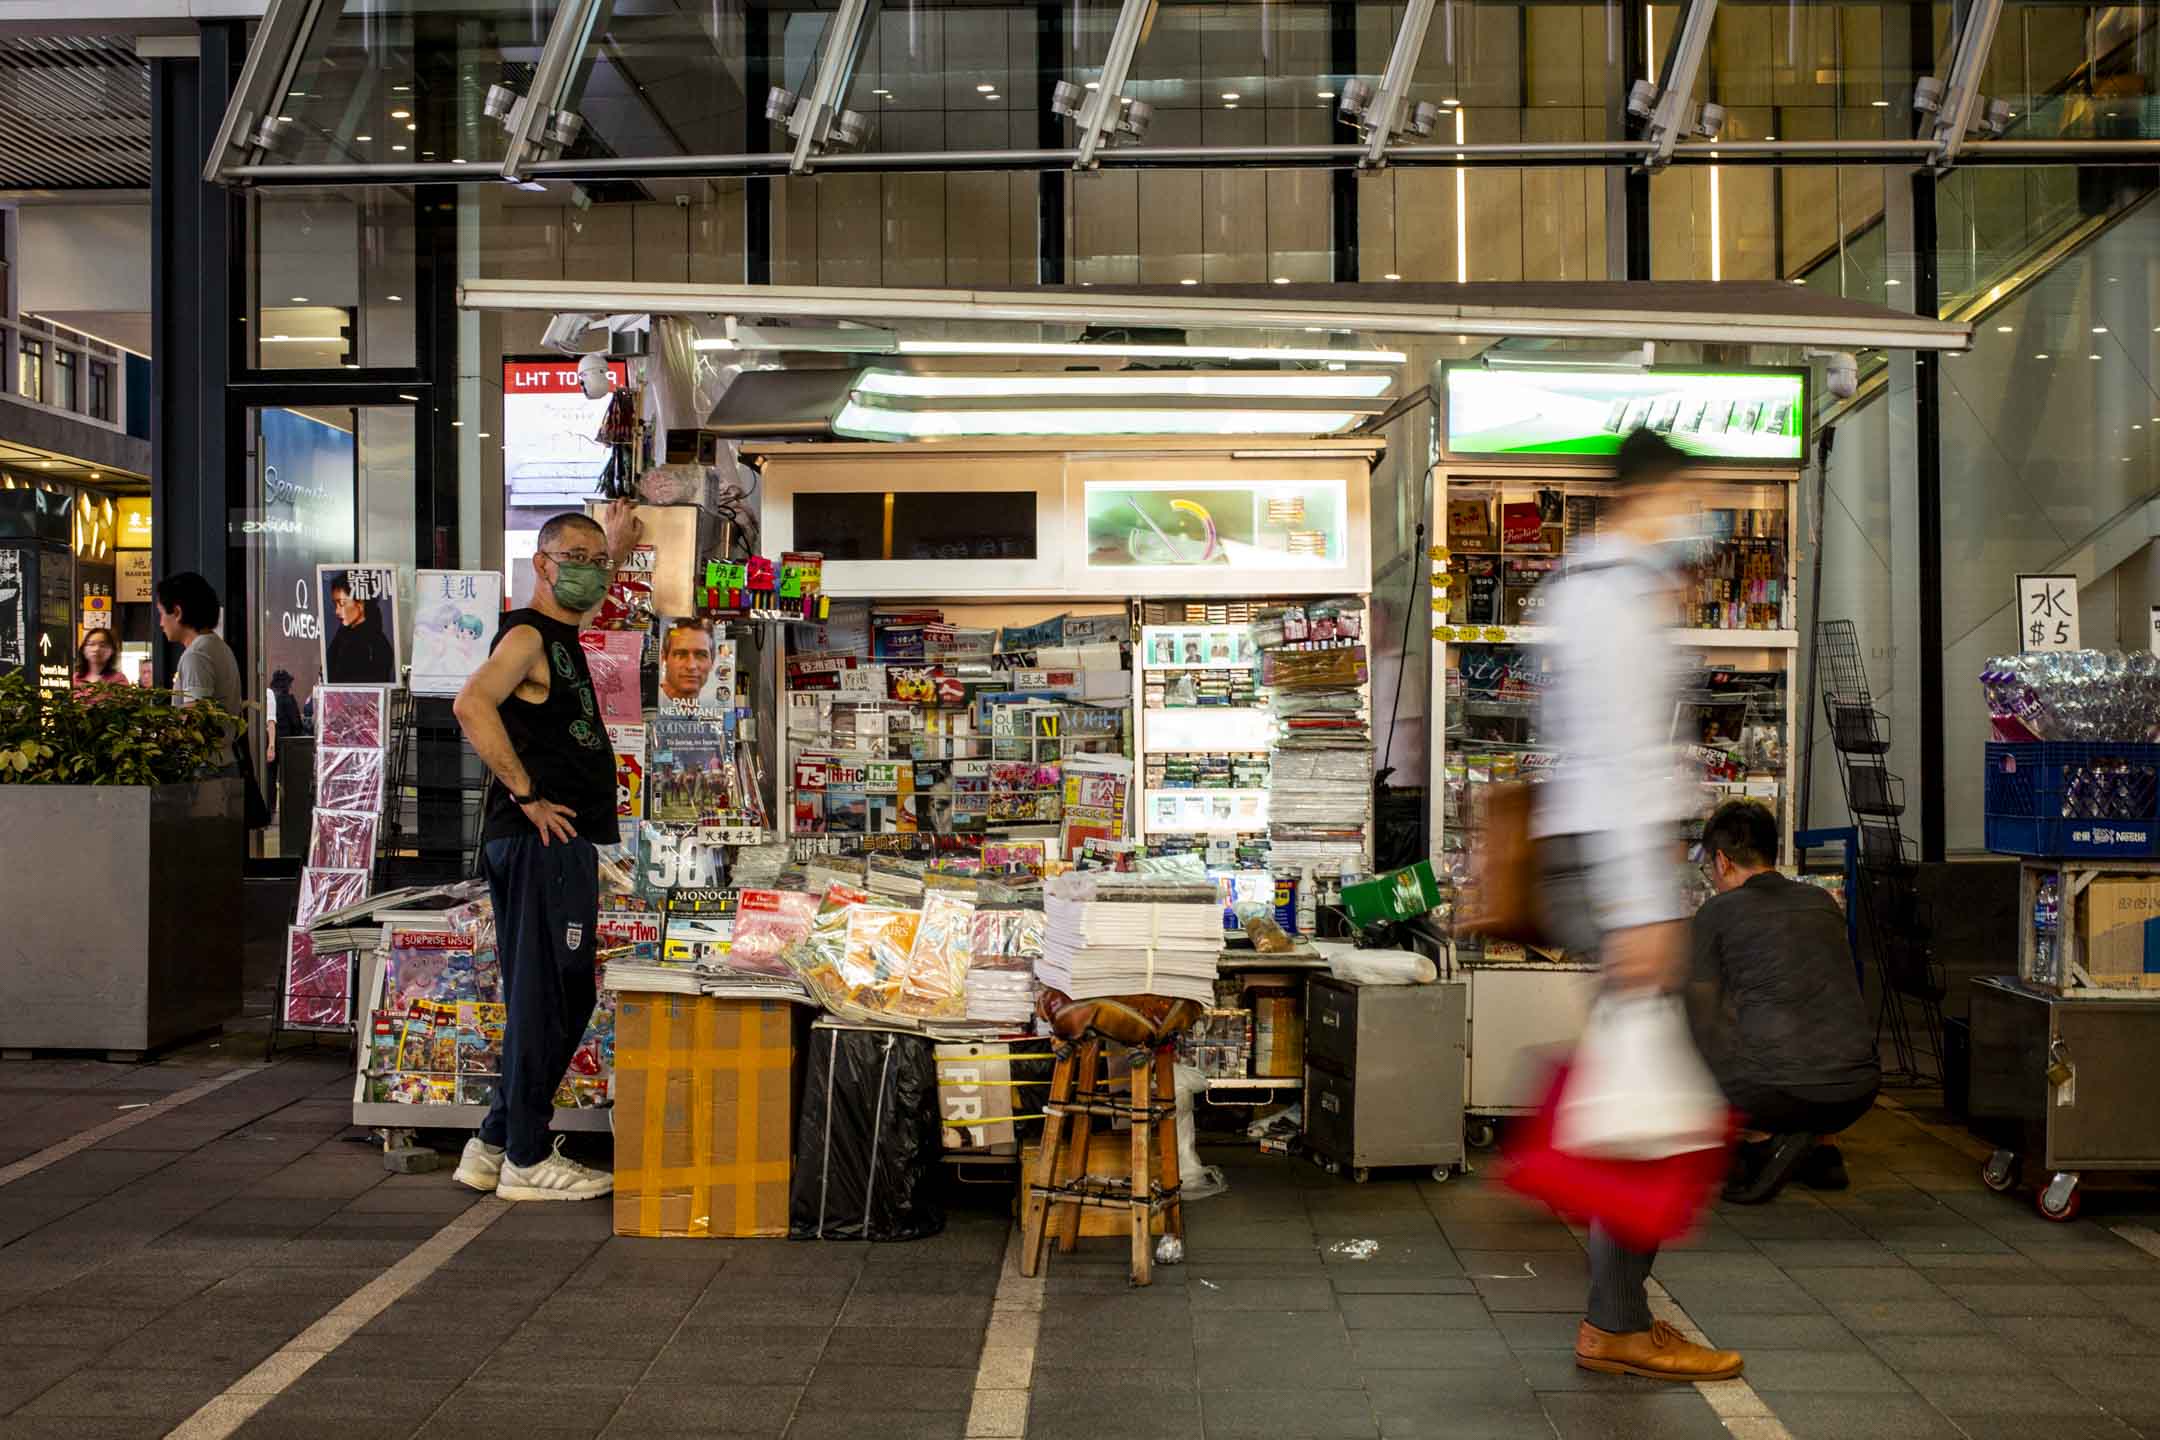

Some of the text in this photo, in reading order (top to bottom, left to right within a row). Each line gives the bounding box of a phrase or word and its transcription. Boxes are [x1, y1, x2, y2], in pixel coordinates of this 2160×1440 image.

[515, 372, 617, 387] LHT TOR
[2031, 583, 2072, 617] 水
[282, 612, 321, 640] OMEGA
[672, 697, 701, 708] PAUL
[660, 707, 714, 717] NEWMAN
[797, 766, 826, 786] T3
[831, 769, 854, 783] Hi-Fi
[404, 934, 446, 945] SURPRISE
